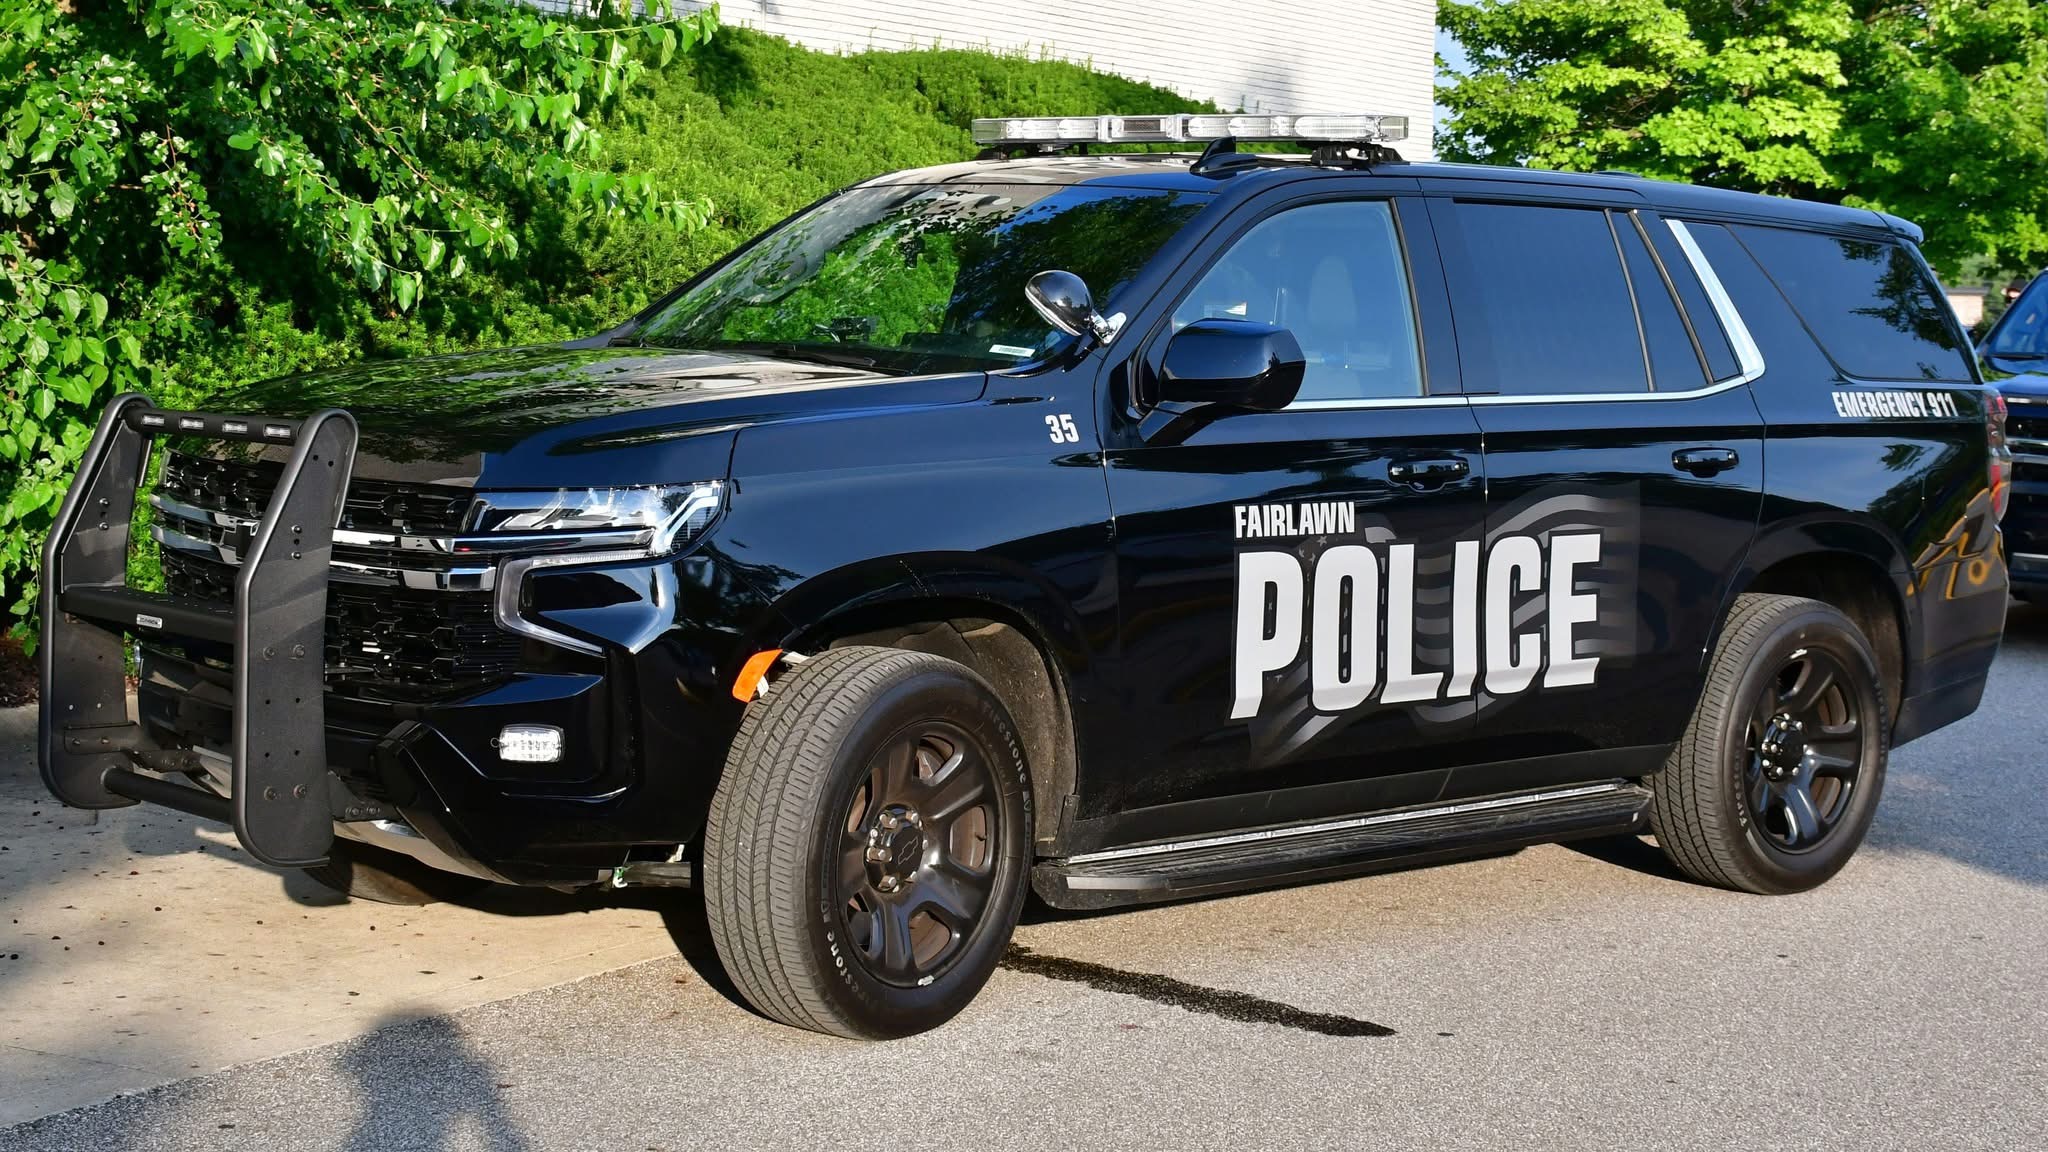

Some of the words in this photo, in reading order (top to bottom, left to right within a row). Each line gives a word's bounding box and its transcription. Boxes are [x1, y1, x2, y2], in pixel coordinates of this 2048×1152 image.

[1831, 391, 1929, 418] EMERGENCY
[1926, 392, 1959, 418] 911
[1044, 413, 1080, 444] 35
[1234, 501, 1355, 538] FAIRLAWN
[1230, 533, 1601, 720] POLICE
